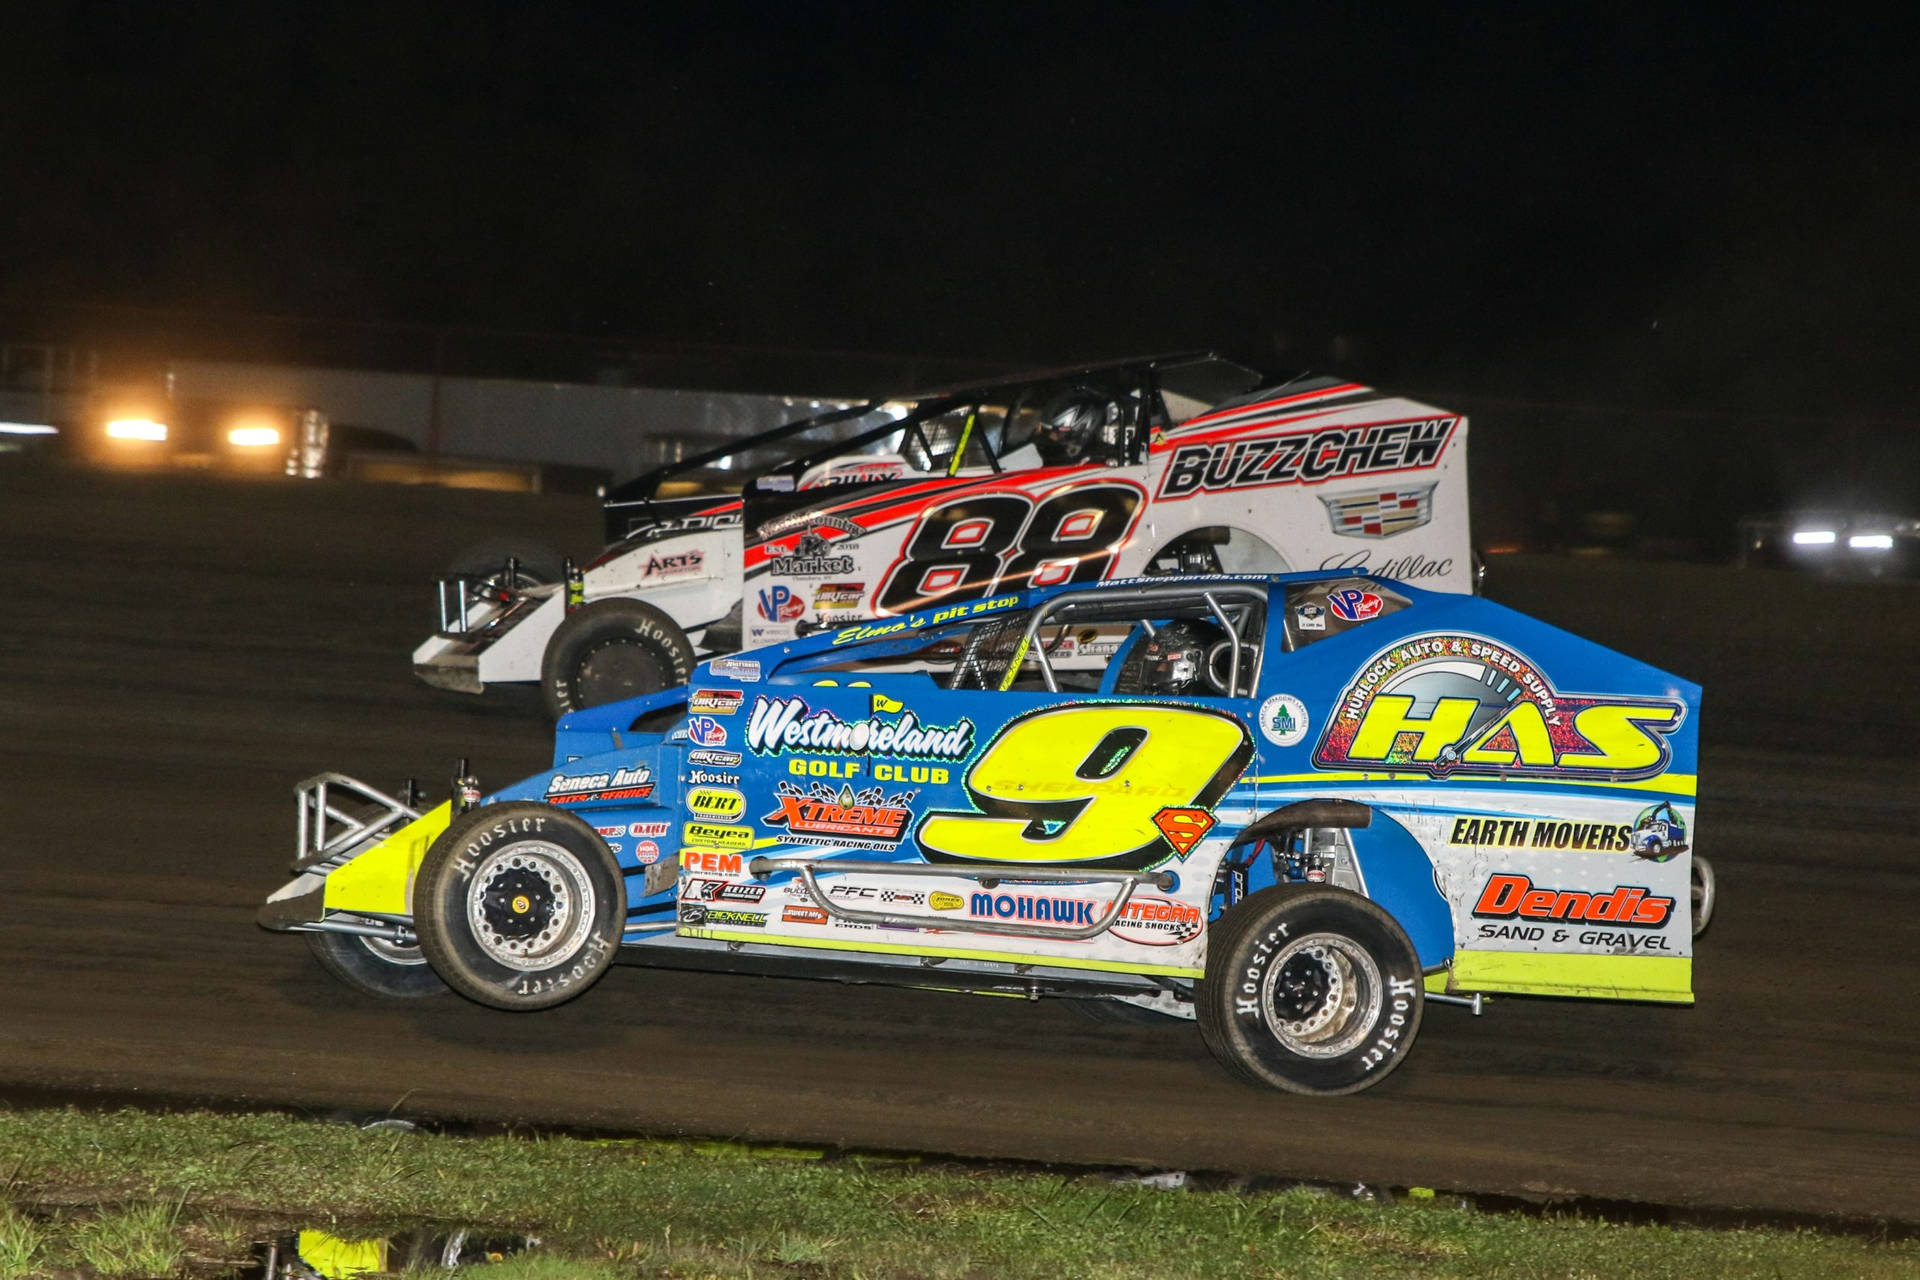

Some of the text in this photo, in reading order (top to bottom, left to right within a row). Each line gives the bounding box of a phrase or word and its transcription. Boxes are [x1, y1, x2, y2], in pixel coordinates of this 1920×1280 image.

[1160, 419, 1454, 497] BUZZCHEW
[874, 481, 1146, 616] 88
[771, 555, 854, 576] Market
[1320, 550, 1452, 581] Cdillac
[1326, 589, 1364, 620] VP
[833, 595, 1019, 646] Elmo's pit stop
[634, 618, 689, 687] Hoosier
[1345, 640, 1561, 727] HURLOCK AUTO & SPEED SUPPLY
[689, 716, 716, 745] VP
[748, 697, 974, 760] Westmoreland
[1272, 716, 1296, 729] SMI
[1346, 694, 1678, 769] HAS
[609, 767, 652, 787] Auto
[688, 770, 741, 785] Hoosier
[788, 759, 950, 785] GOLF CLUB
[916, 704, 1248, 866] 9
[692, 795, 741, 811] BERT
[767, 794, 908, 828] XTREME
[688, 825, 750, 840] Beyea
[776, 834, 896, 852] SYNTHETIC RACING OILS
[794, 820, 896, 837] LUBRICANTS
[1450, 818, 1633, 851] EARTH MOVERS
[452, 816, 547, 883] Hoosier
[683, 852, 742, 873] PEM
[724, 885, 764, 895] KEIZER
[829, 885, 879, 898] PFC
[1472, 873, 1675, 929] Dendis
[706, 910, 766, 923] BICKNELL
[970, 892, 1095, 924] MOHAWK
[1145, 922, 1182, 932] SHOCKS
[1478, 924, 1672, 951] SAND & GRAVEL
[517, 930, 611, 996] Hoosier
[1236, 922, 1291, 1019] Hoosier
[1361, 975, 1417, 1071] Hoosier
